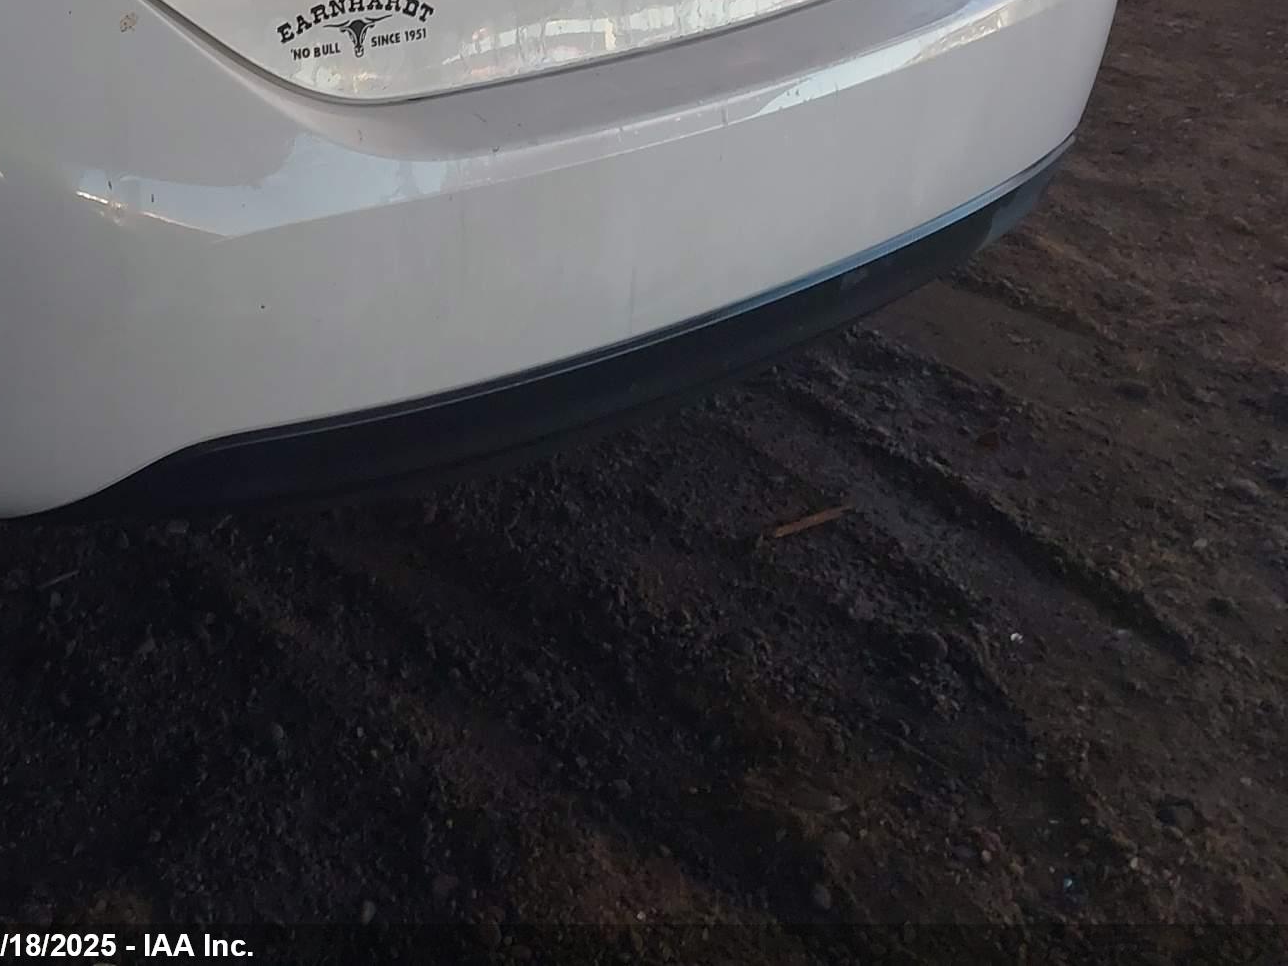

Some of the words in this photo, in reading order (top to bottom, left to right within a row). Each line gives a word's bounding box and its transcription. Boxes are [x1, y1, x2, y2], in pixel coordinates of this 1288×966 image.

[371, 32, 401, 48] SINCE
[404, 28, 427, 43] 1951
[314, 42, 341, 58] BULL
